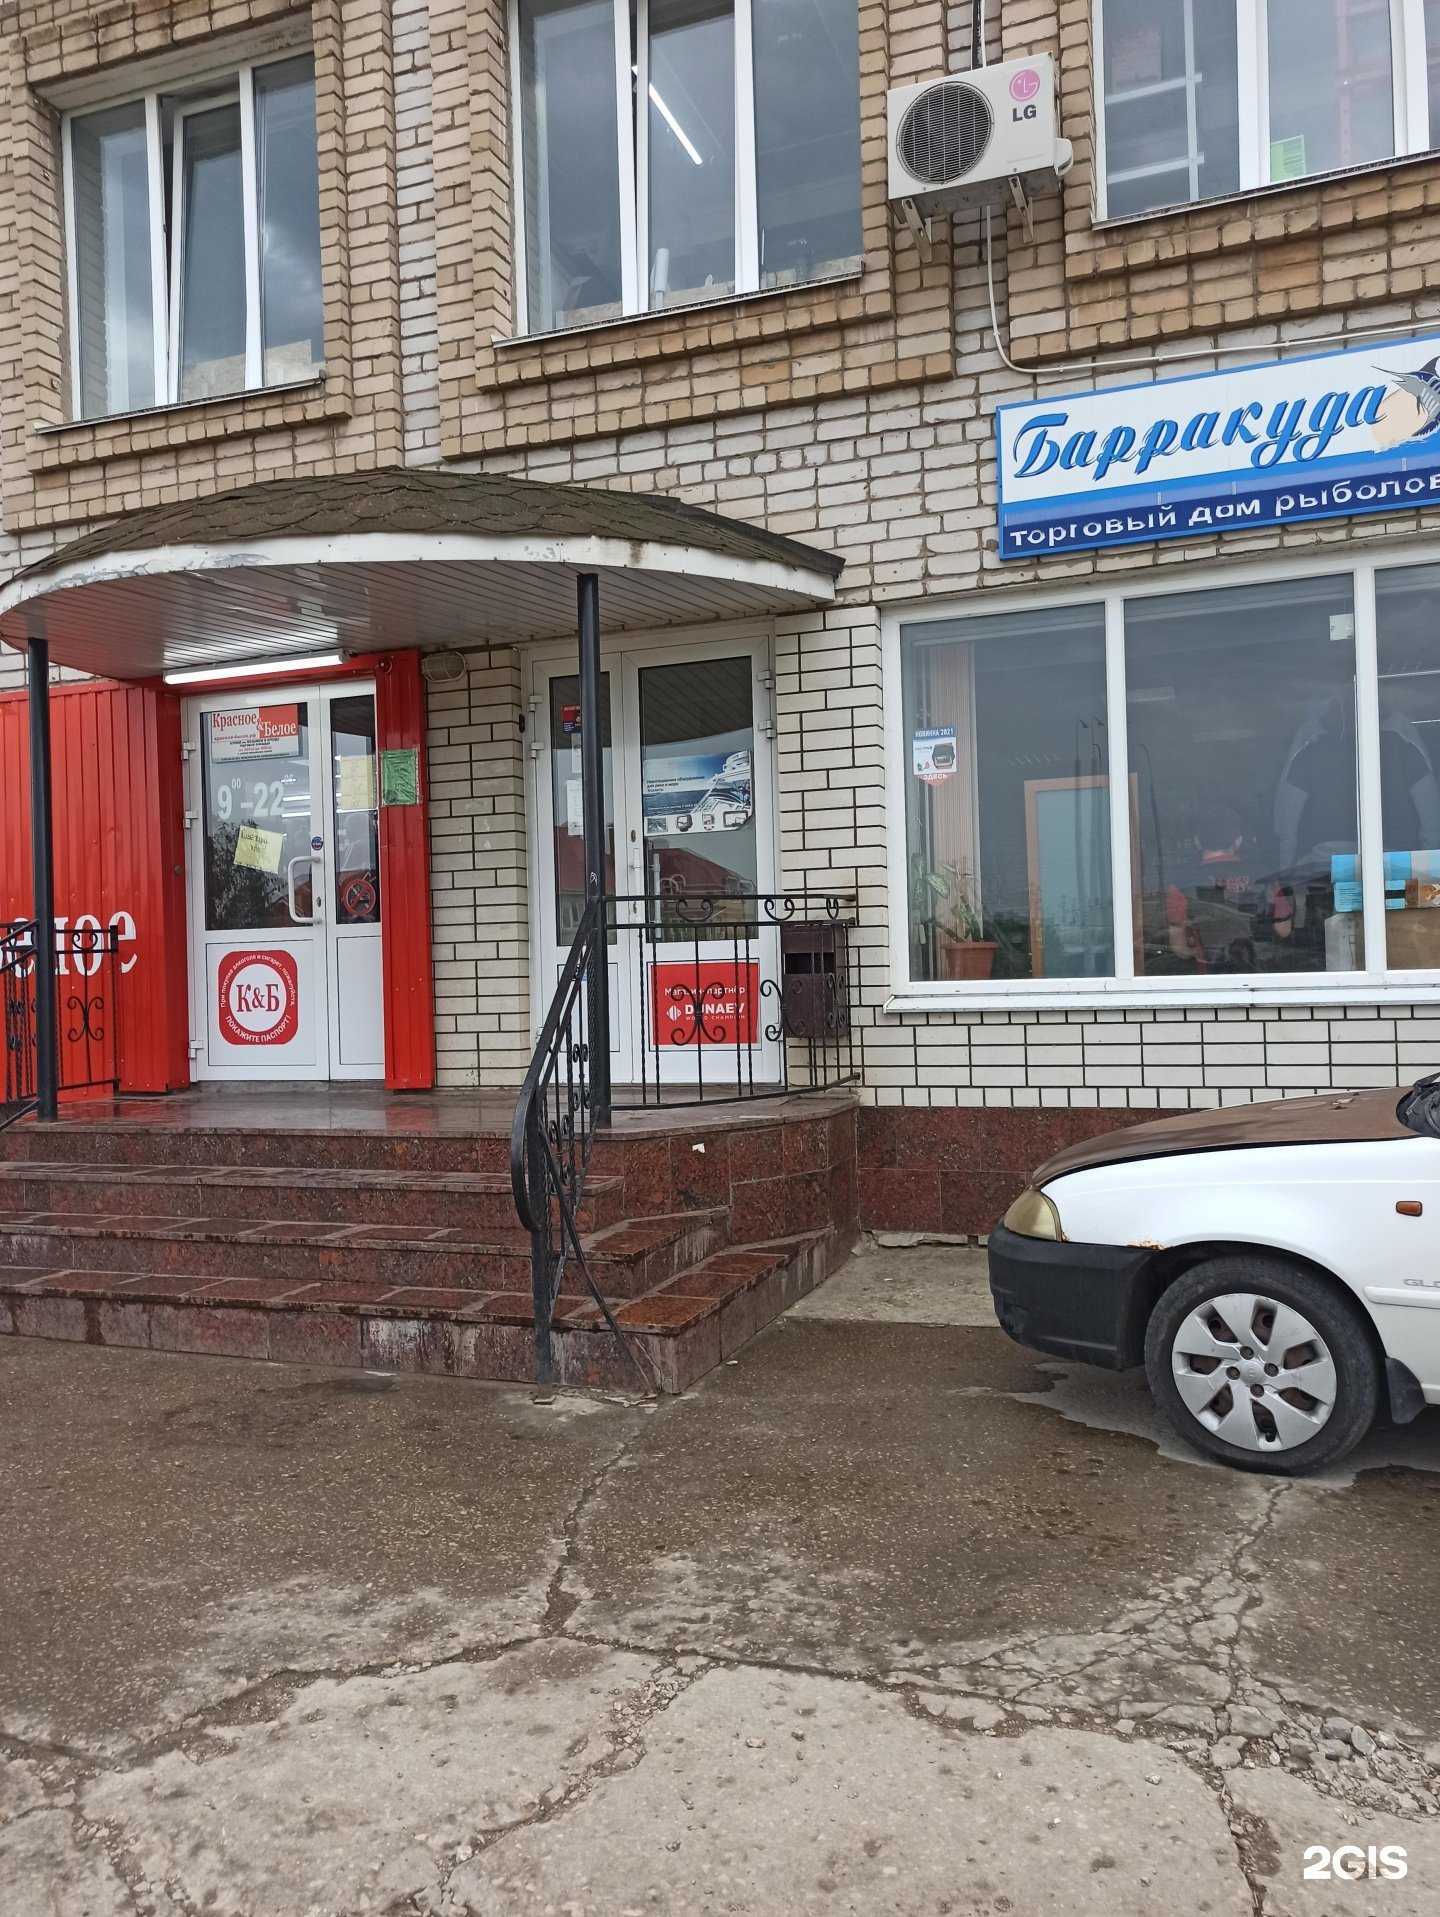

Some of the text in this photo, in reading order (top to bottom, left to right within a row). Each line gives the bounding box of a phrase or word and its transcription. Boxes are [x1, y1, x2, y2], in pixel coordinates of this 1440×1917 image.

[1012, 104, 1037, 122] LG
[1013, 384, 1390, 481] Барракуда
[1010, 504, 1177, 548] торговый
[1188, 498, 1262, 527] дом
[212, 712, 257, 732] Красное
[263, 720, 297, 737] Белое
[236, 983, 280, 1013] К&Б
[685, 1002, 745, 1015] DNAEV
[225, 1015, 262, 1043] ПОКАЖИТЕ
